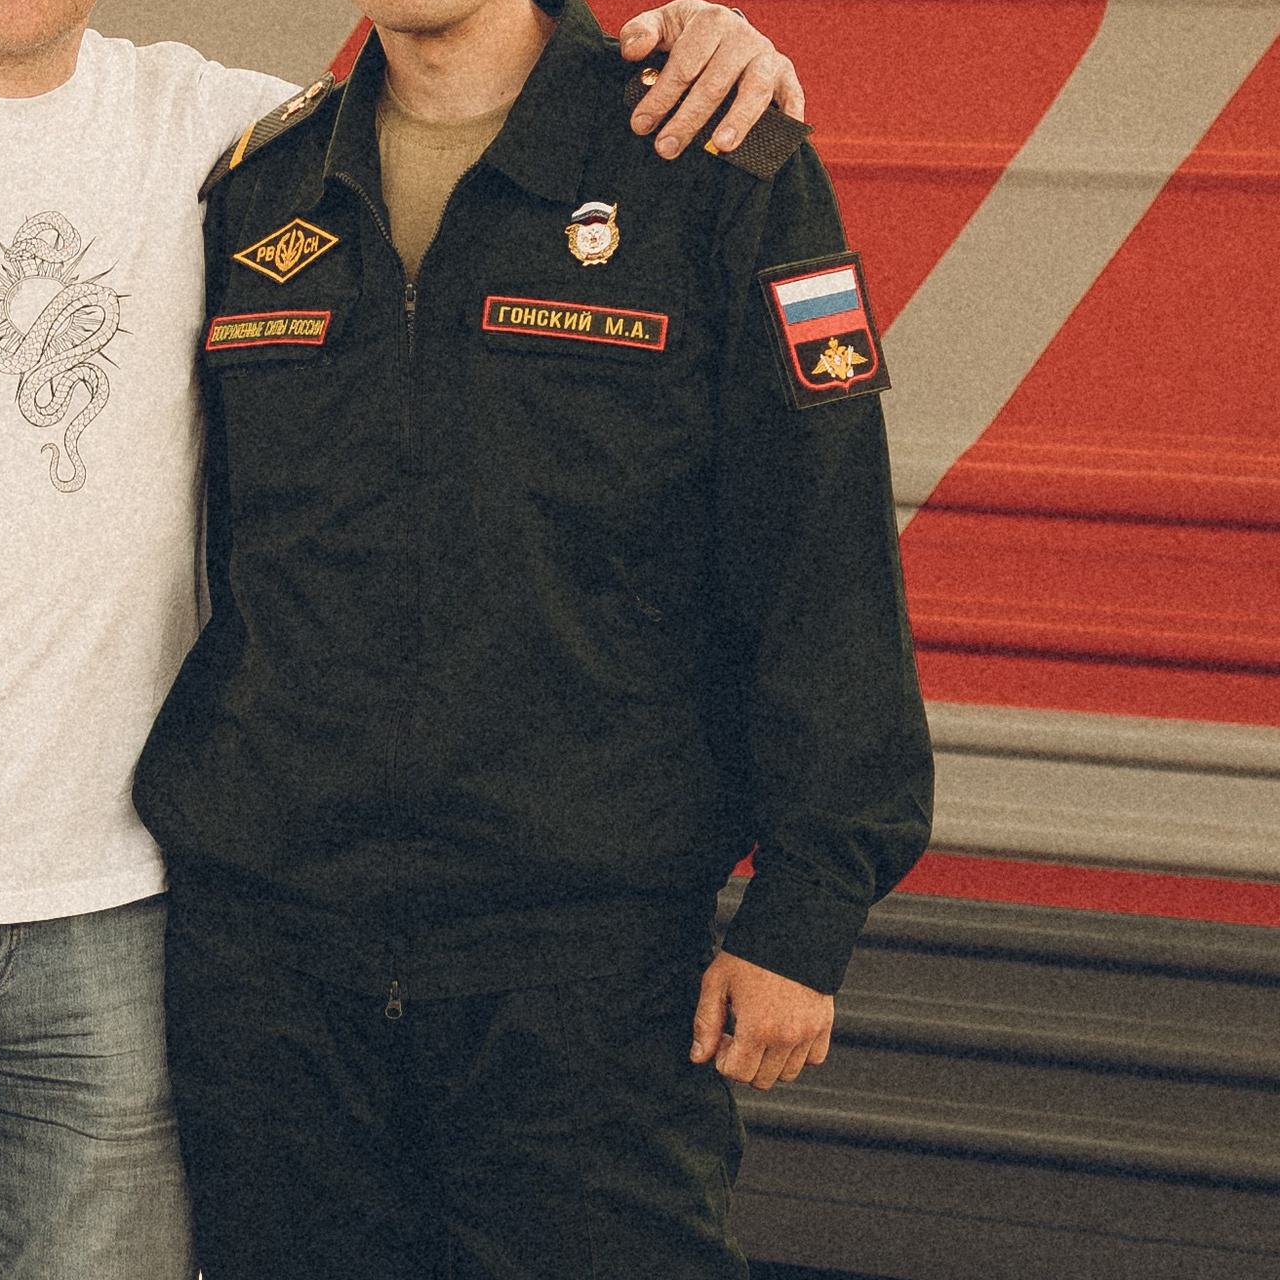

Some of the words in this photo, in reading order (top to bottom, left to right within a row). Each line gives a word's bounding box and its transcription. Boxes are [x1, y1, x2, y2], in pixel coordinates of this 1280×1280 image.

[288, 319, 325, 336] РОССИИ
[498, 306, 592, 332] ГОНСКИЙ
[605, 316, 650, 340] М.А.
